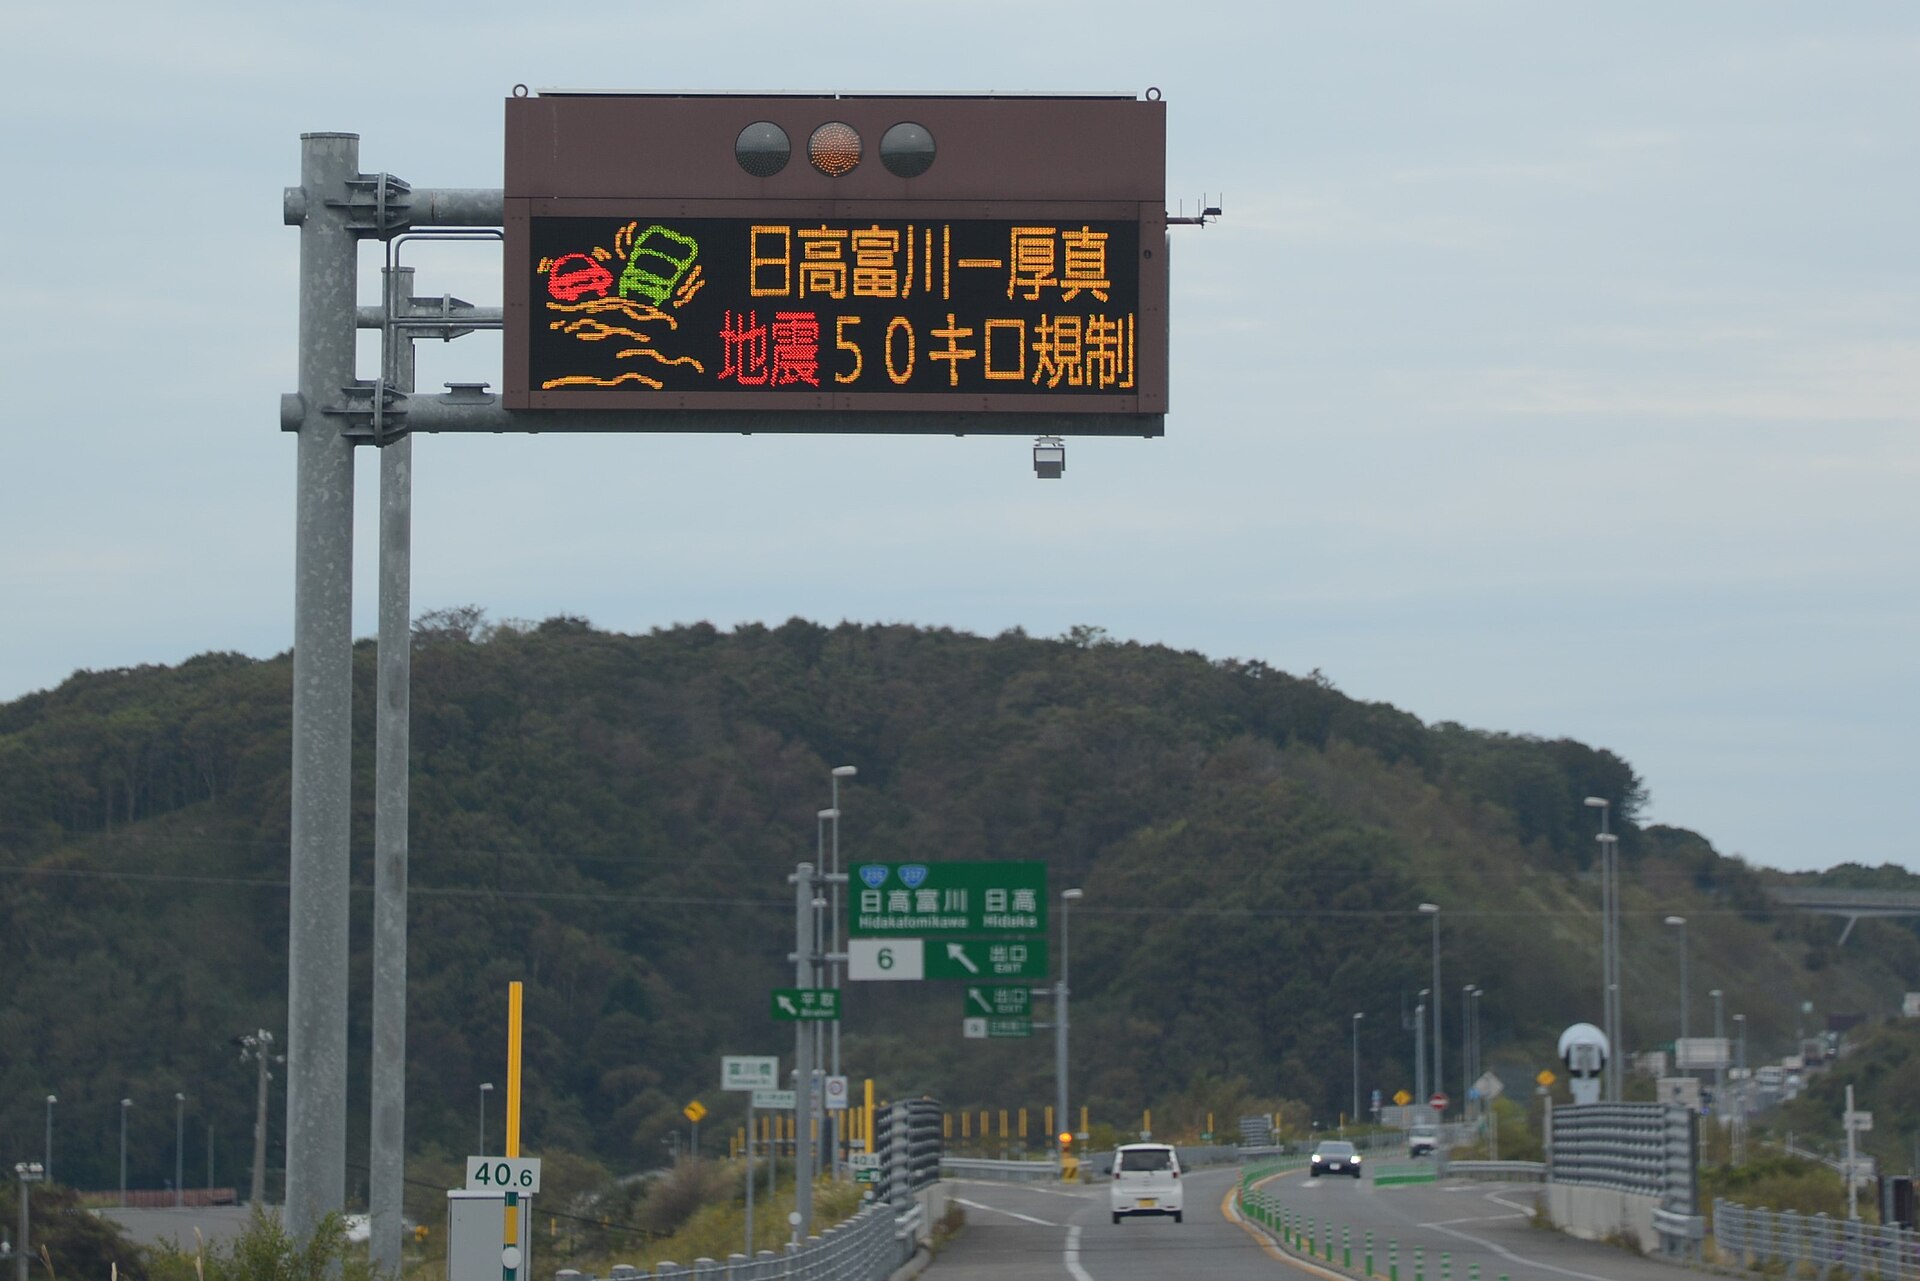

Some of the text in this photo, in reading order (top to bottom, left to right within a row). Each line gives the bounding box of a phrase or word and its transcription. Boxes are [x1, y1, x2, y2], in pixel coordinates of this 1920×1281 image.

[861, 888, 1037, 913] 日高富川 日高
[983, 914, 1038, 928] Hidaka
[878, 948, 894, 970] 6
[990, 945, 1028, 962] 出口
[475, 1162, 533, 1187] 40.6
